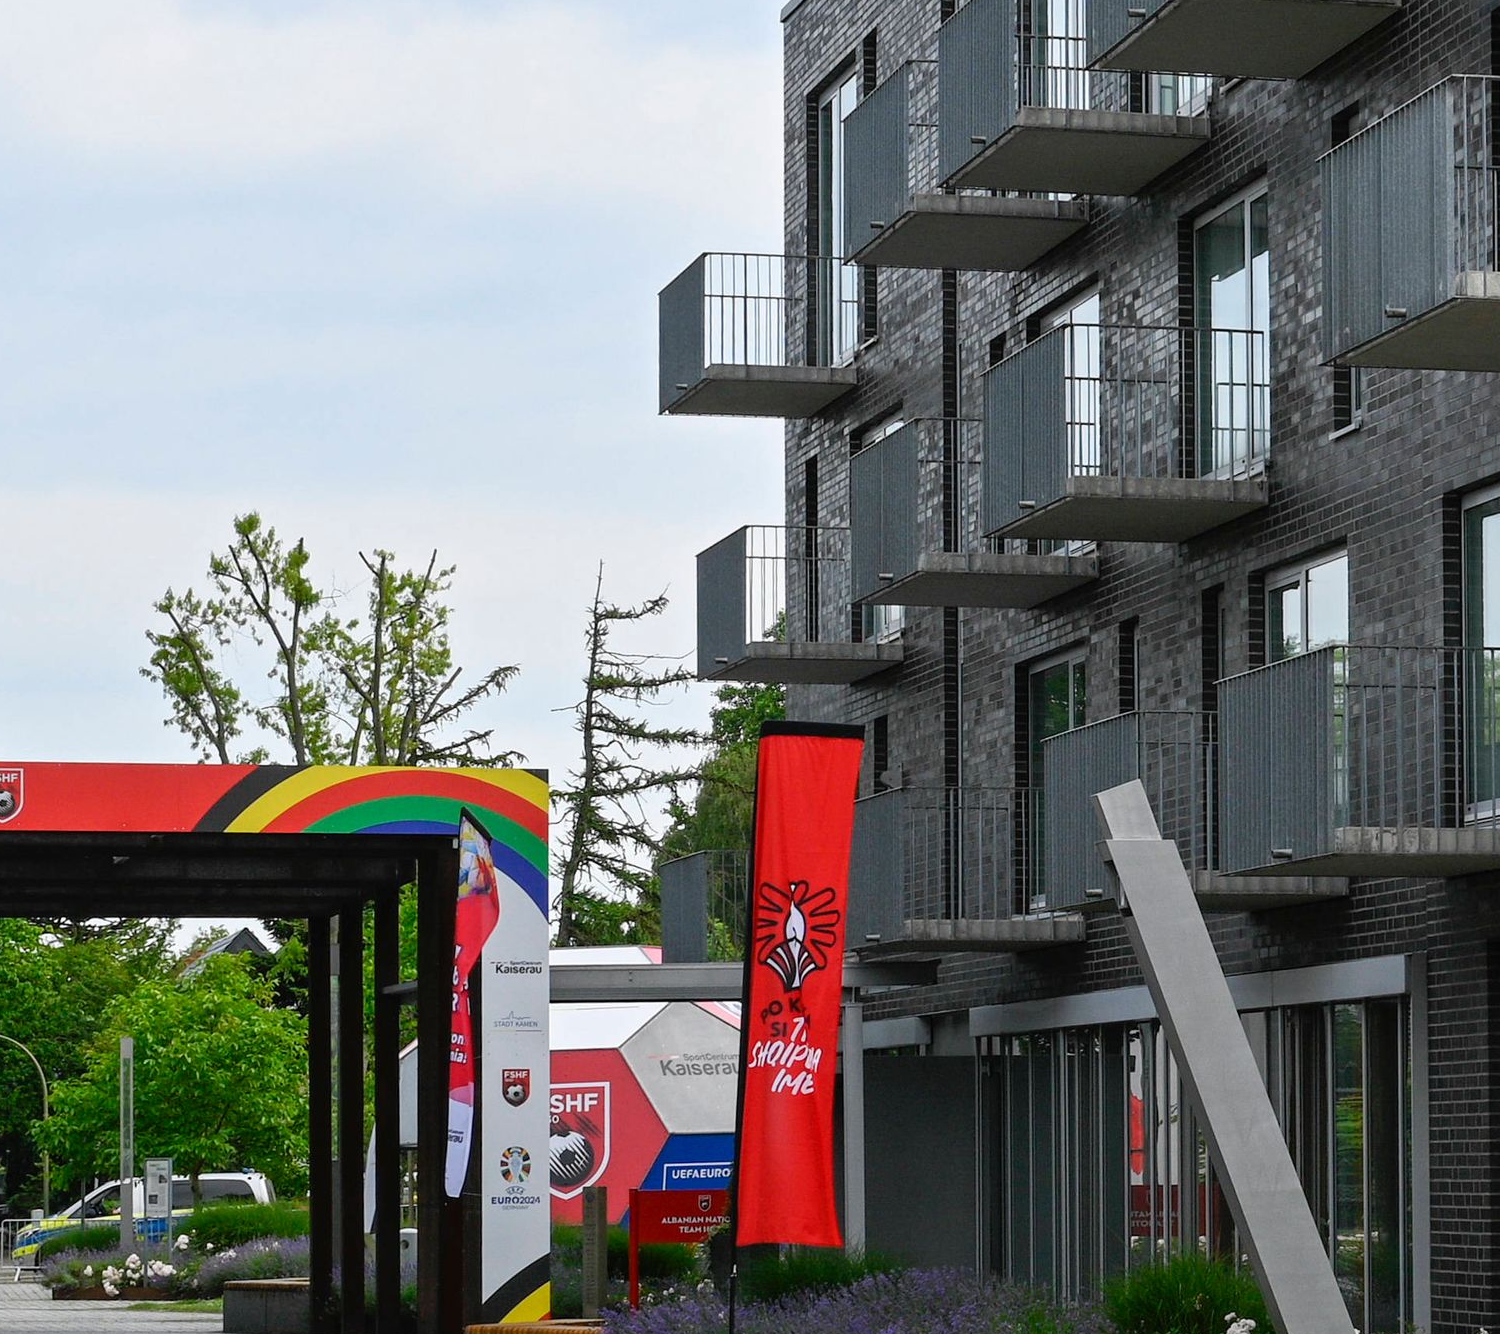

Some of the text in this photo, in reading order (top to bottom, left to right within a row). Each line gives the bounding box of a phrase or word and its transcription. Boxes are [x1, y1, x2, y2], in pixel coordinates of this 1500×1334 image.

[495, 964, 543, 974] Kaiserau
[504, 1071, 528, 1080] FSHF
[771, 1068, 815, 1096] IME
[550, 1093, 599, 1114] SHF
[672, 1168, 732, 1179] UEFAEURO
[491, 1197, 541, 1205] EURO2024
[661, 1216, 731, 1224] ALBANIAN NATIO
[679, 1226, 703, 1234] TEAM
